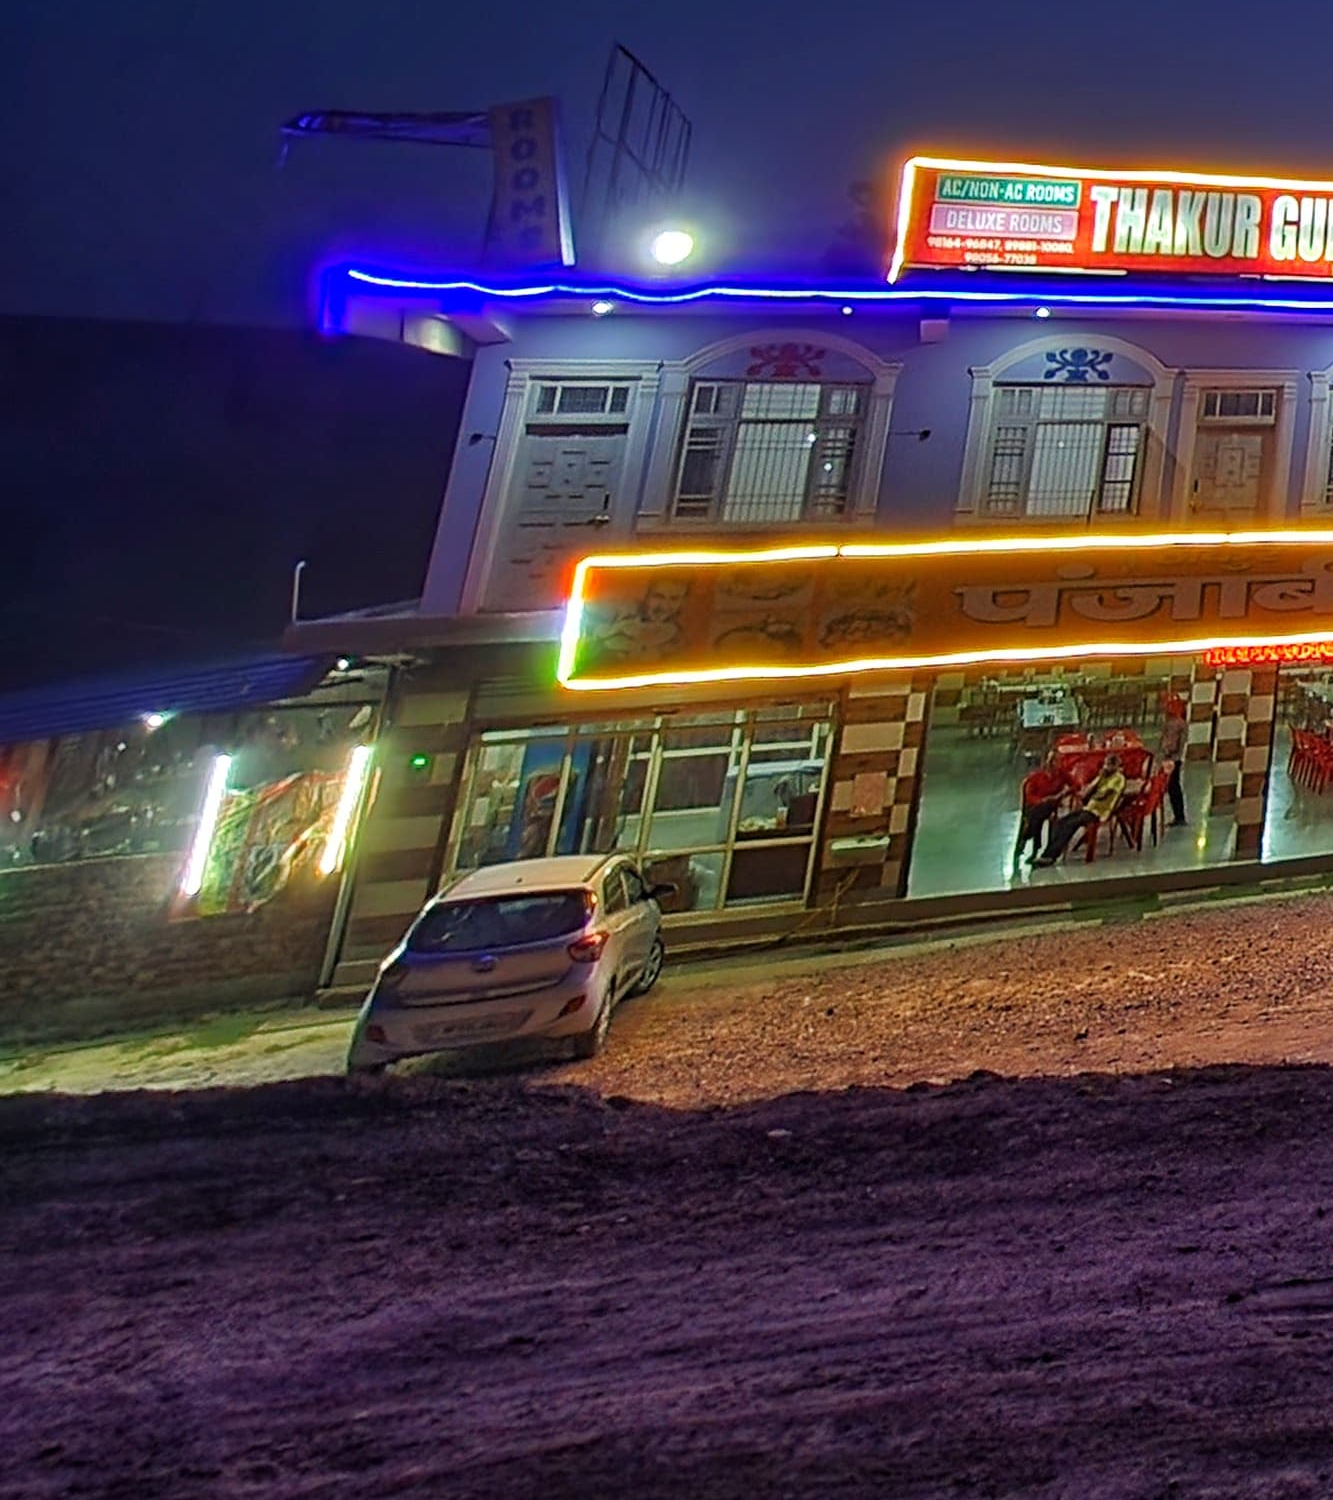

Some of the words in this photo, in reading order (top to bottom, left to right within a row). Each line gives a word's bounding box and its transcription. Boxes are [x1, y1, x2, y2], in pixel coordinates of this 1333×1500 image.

[942, 178, 1023, 200] AC/NON-AC
[1025, 183, 1075, 202] ROOMS
[947, 210, 1006, 231] DELUXE
[1009, 214, 1063, 233] ROOMS
[1090, 185, 1262, 259] THAKUR
